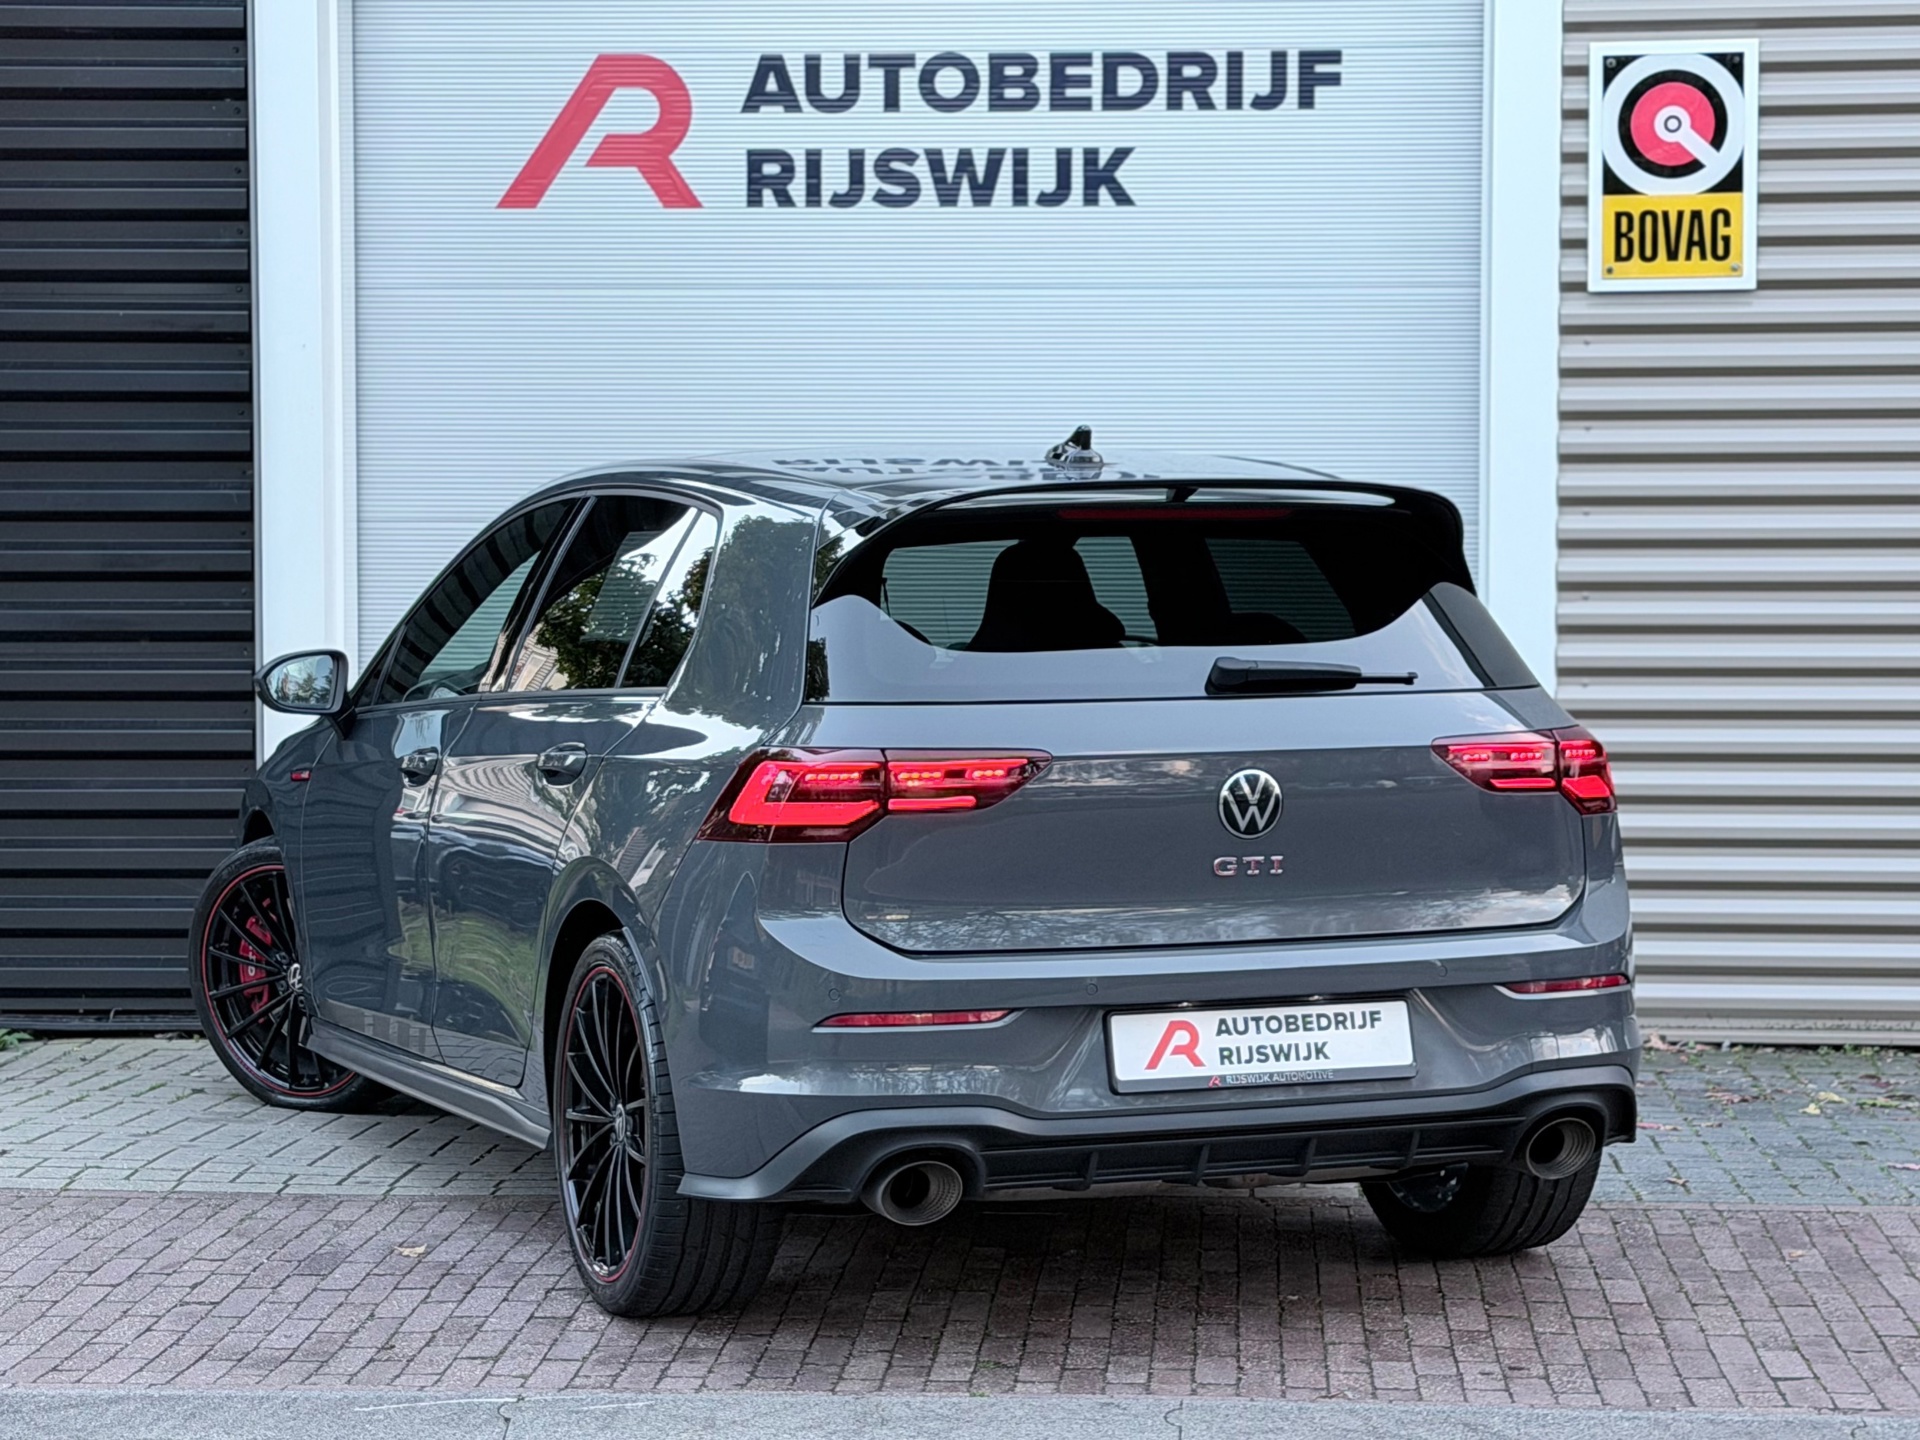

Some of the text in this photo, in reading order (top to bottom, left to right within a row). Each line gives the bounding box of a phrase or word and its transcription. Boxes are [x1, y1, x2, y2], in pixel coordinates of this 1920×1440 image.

[740, 49, 1343, 114] AUTOBEDRIJF
[745, 147, 1138, 208] RIJSWIJK
[1613, 208, 1732, 263] BOVAG
[1213, 855, 1284, 876] GTI
[1215, 1010, 1383, 1037] AUTOBEDRIJF
[1218, 1041, 1331, 1066] RIJSWIJK
[1225, 1070, 1334, 1085] RIJSWIJK AUTOMOTIVE
